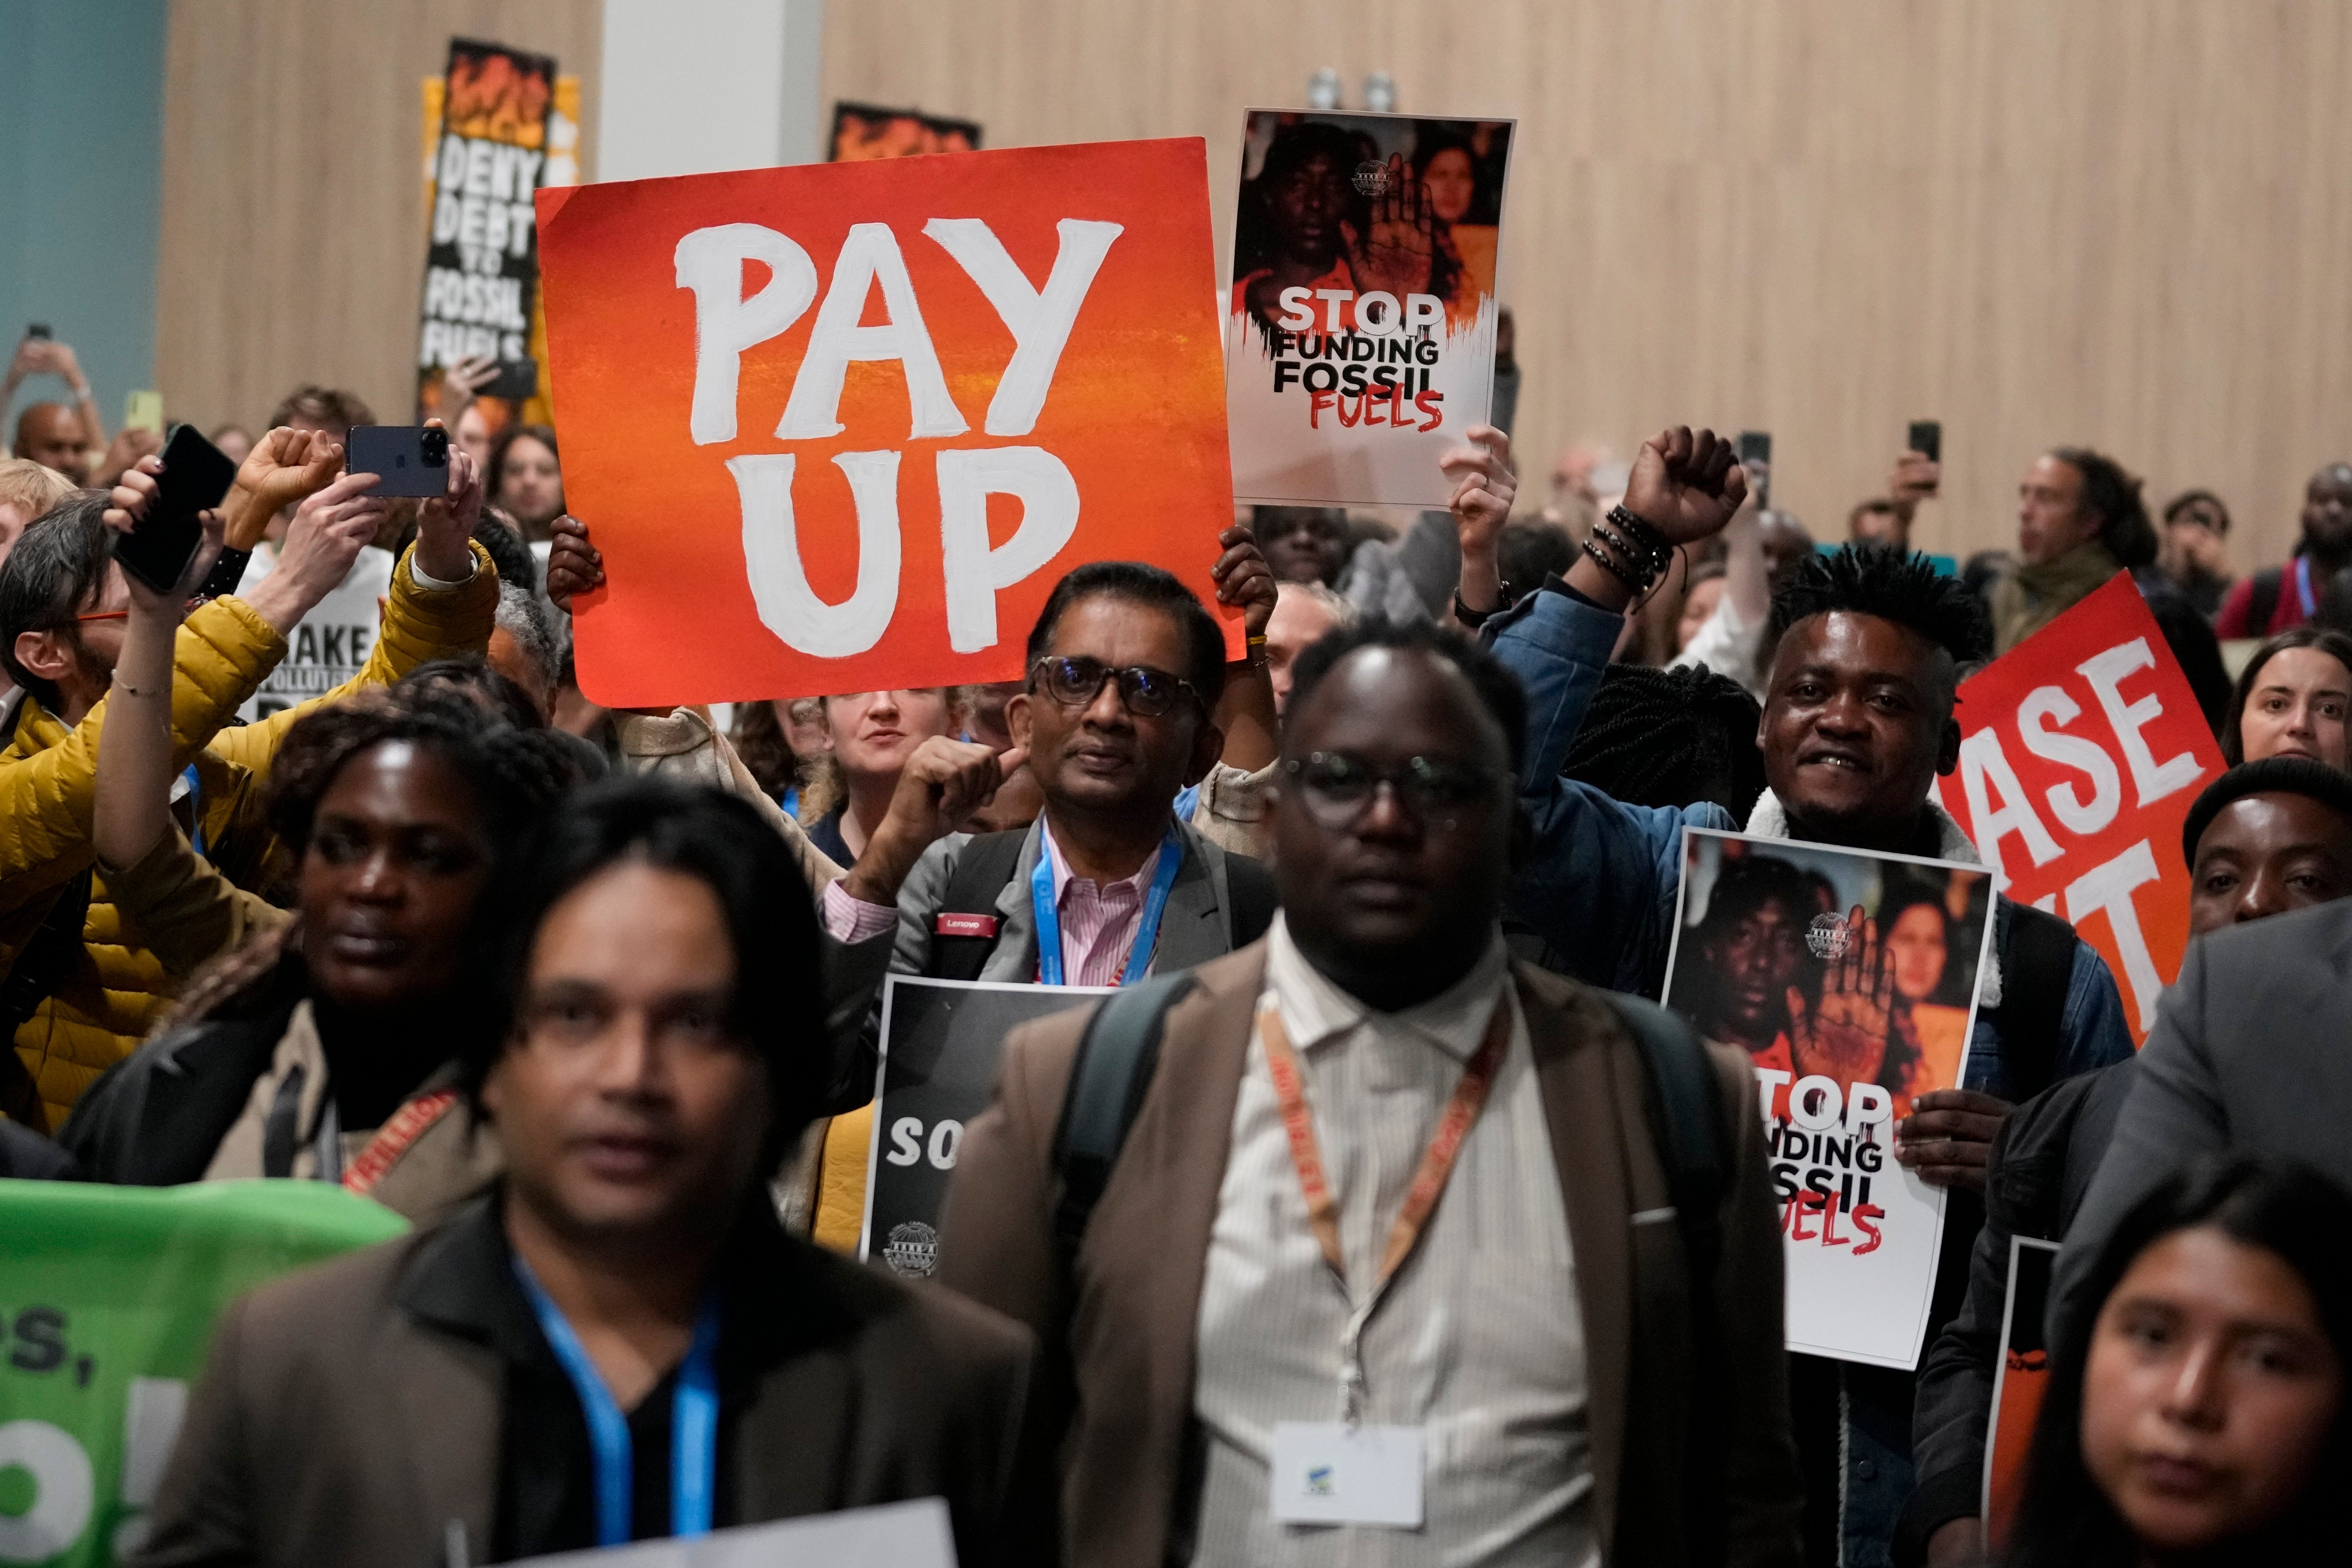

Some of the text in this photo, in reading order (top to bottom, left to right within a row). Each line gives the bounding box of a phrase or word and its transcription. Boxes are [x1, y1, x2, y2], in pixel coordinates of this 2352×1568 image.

[441, 134, 542, 202] DENY
[432, 193, 536, 257] DEBT
[460, 248, 502, 275] TO
[426, 268, 527, 330] FOSSIL
[1277, 286, 1444, 336] STOP
[674, 218, 1124, 445] PAY
[1276, 333, 1439, 365] FUNDING
[1274, 361, 1444, 401] FOSSIL
[1311, 382, 1443, 432] FUELS
[725, 446, 1080, 658] UP
[1927, 636, 2206, 893] ASE
[946, 919, 980, 929] Lenovo
[2031, 839, 2164, 1033] T
[1755, 1067, 1893, 1135] TOP
[1769, 1126, 1883, 1173] DING
[1770, 1162, 1886, 1219] SSIL
[1781, 1188, 1882, 1255] ELS
